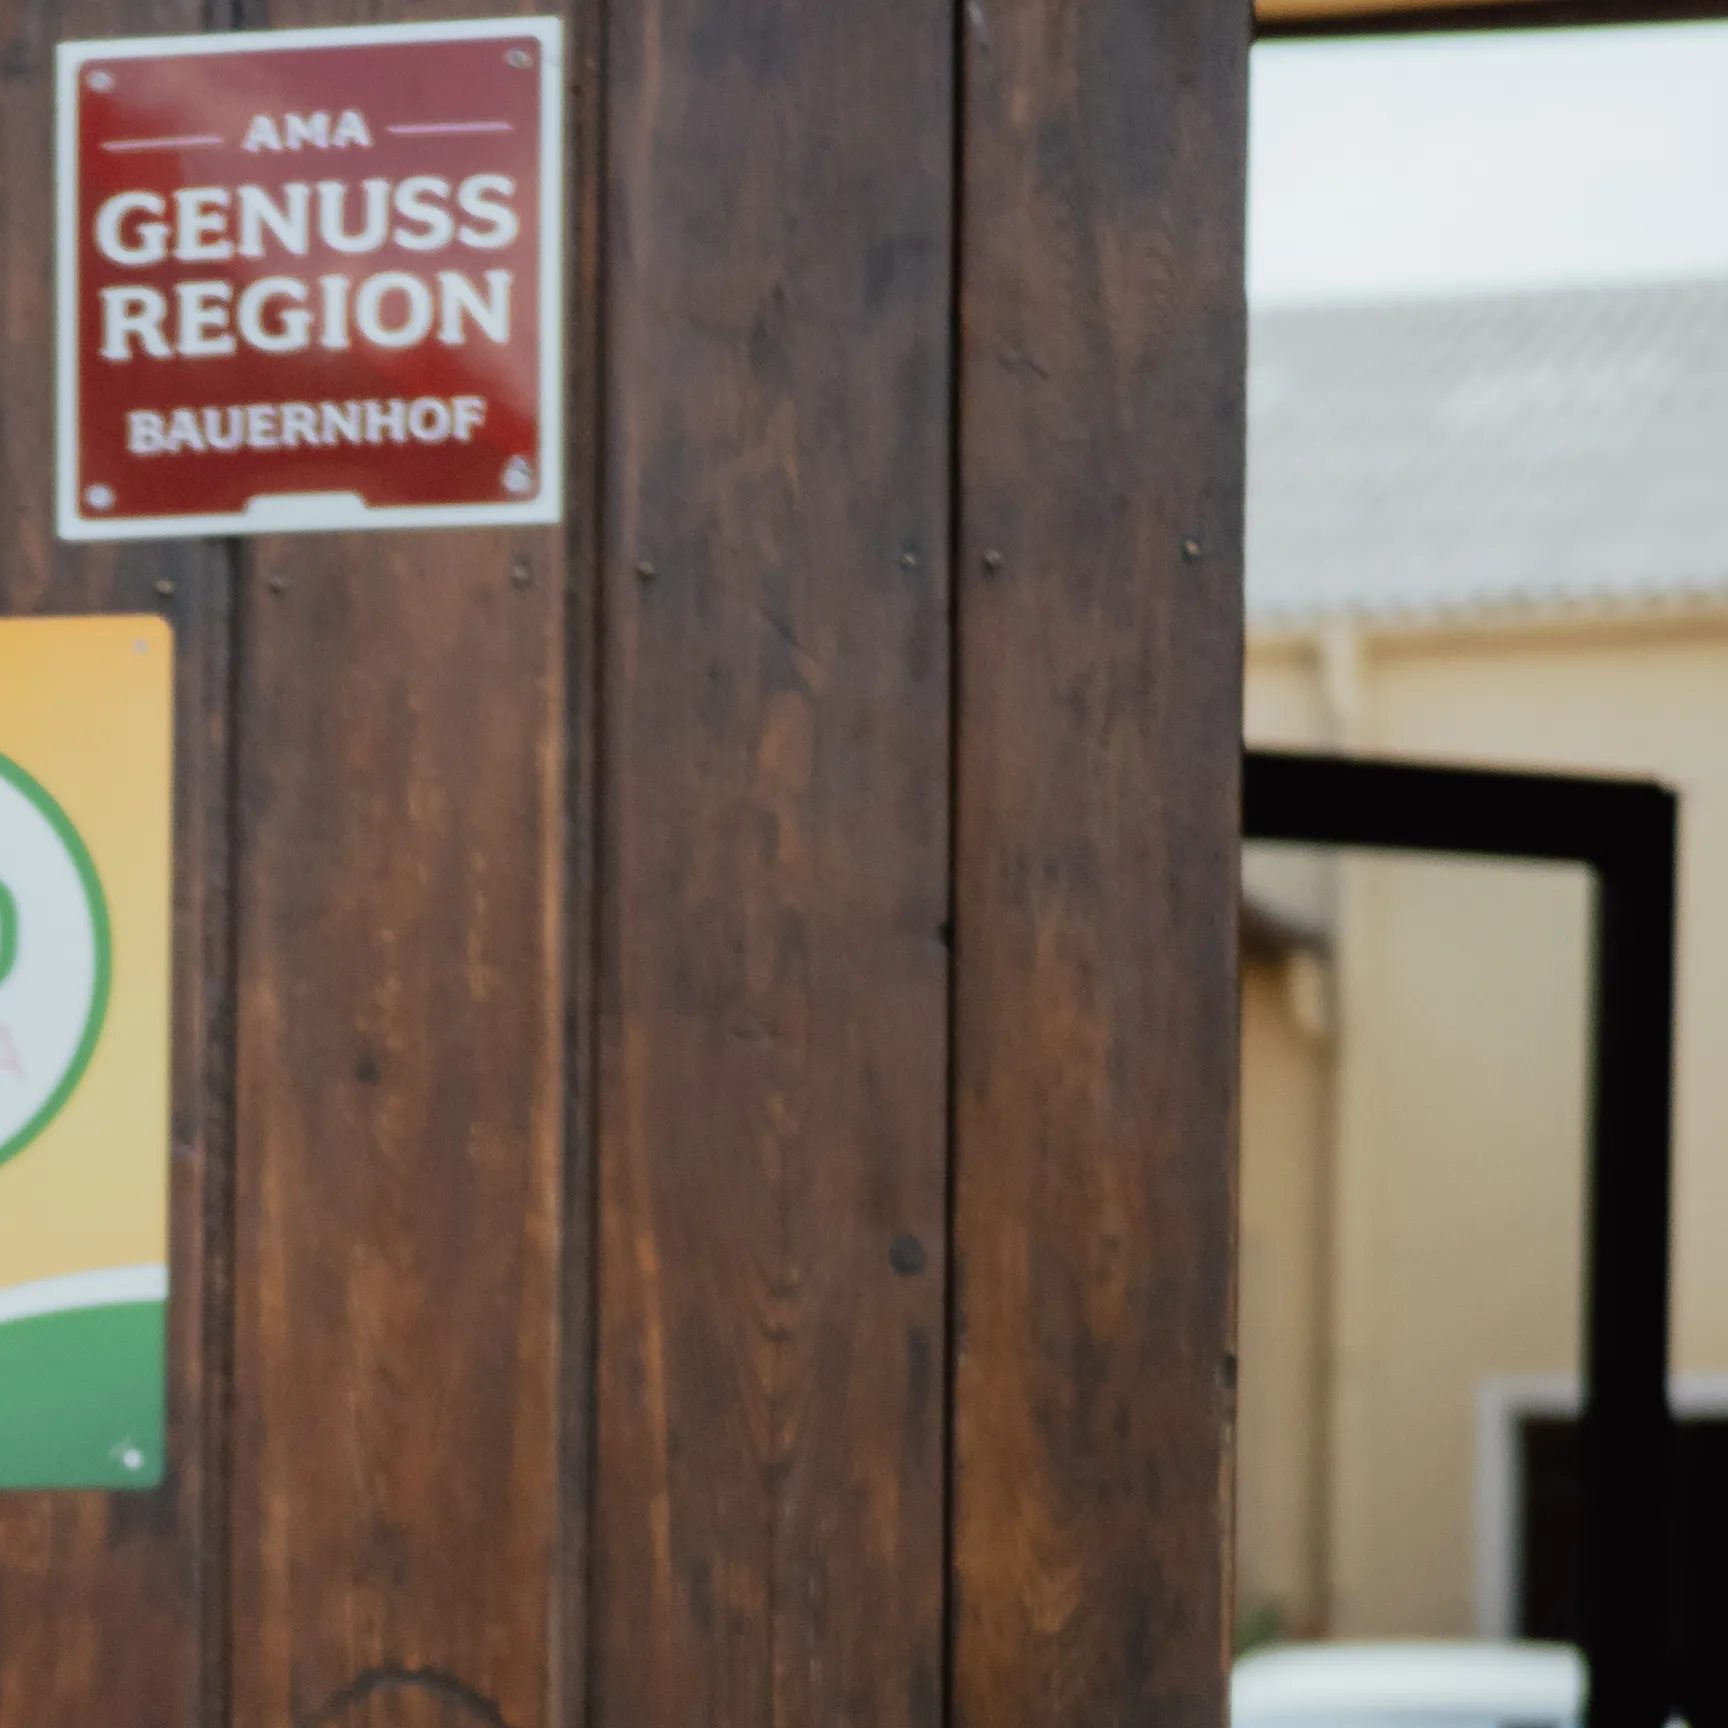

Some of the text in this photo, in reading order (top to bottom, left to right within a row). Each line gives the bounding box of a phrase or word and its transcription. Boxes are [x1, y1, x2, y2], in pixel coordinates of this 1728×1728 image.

[243, 110, 372, 152] AMA
[95, 173, 519, 266] GENUSS
[99, 269, 513, 363] REGION
[127, 395, 486, 457] BAUERNHOF
